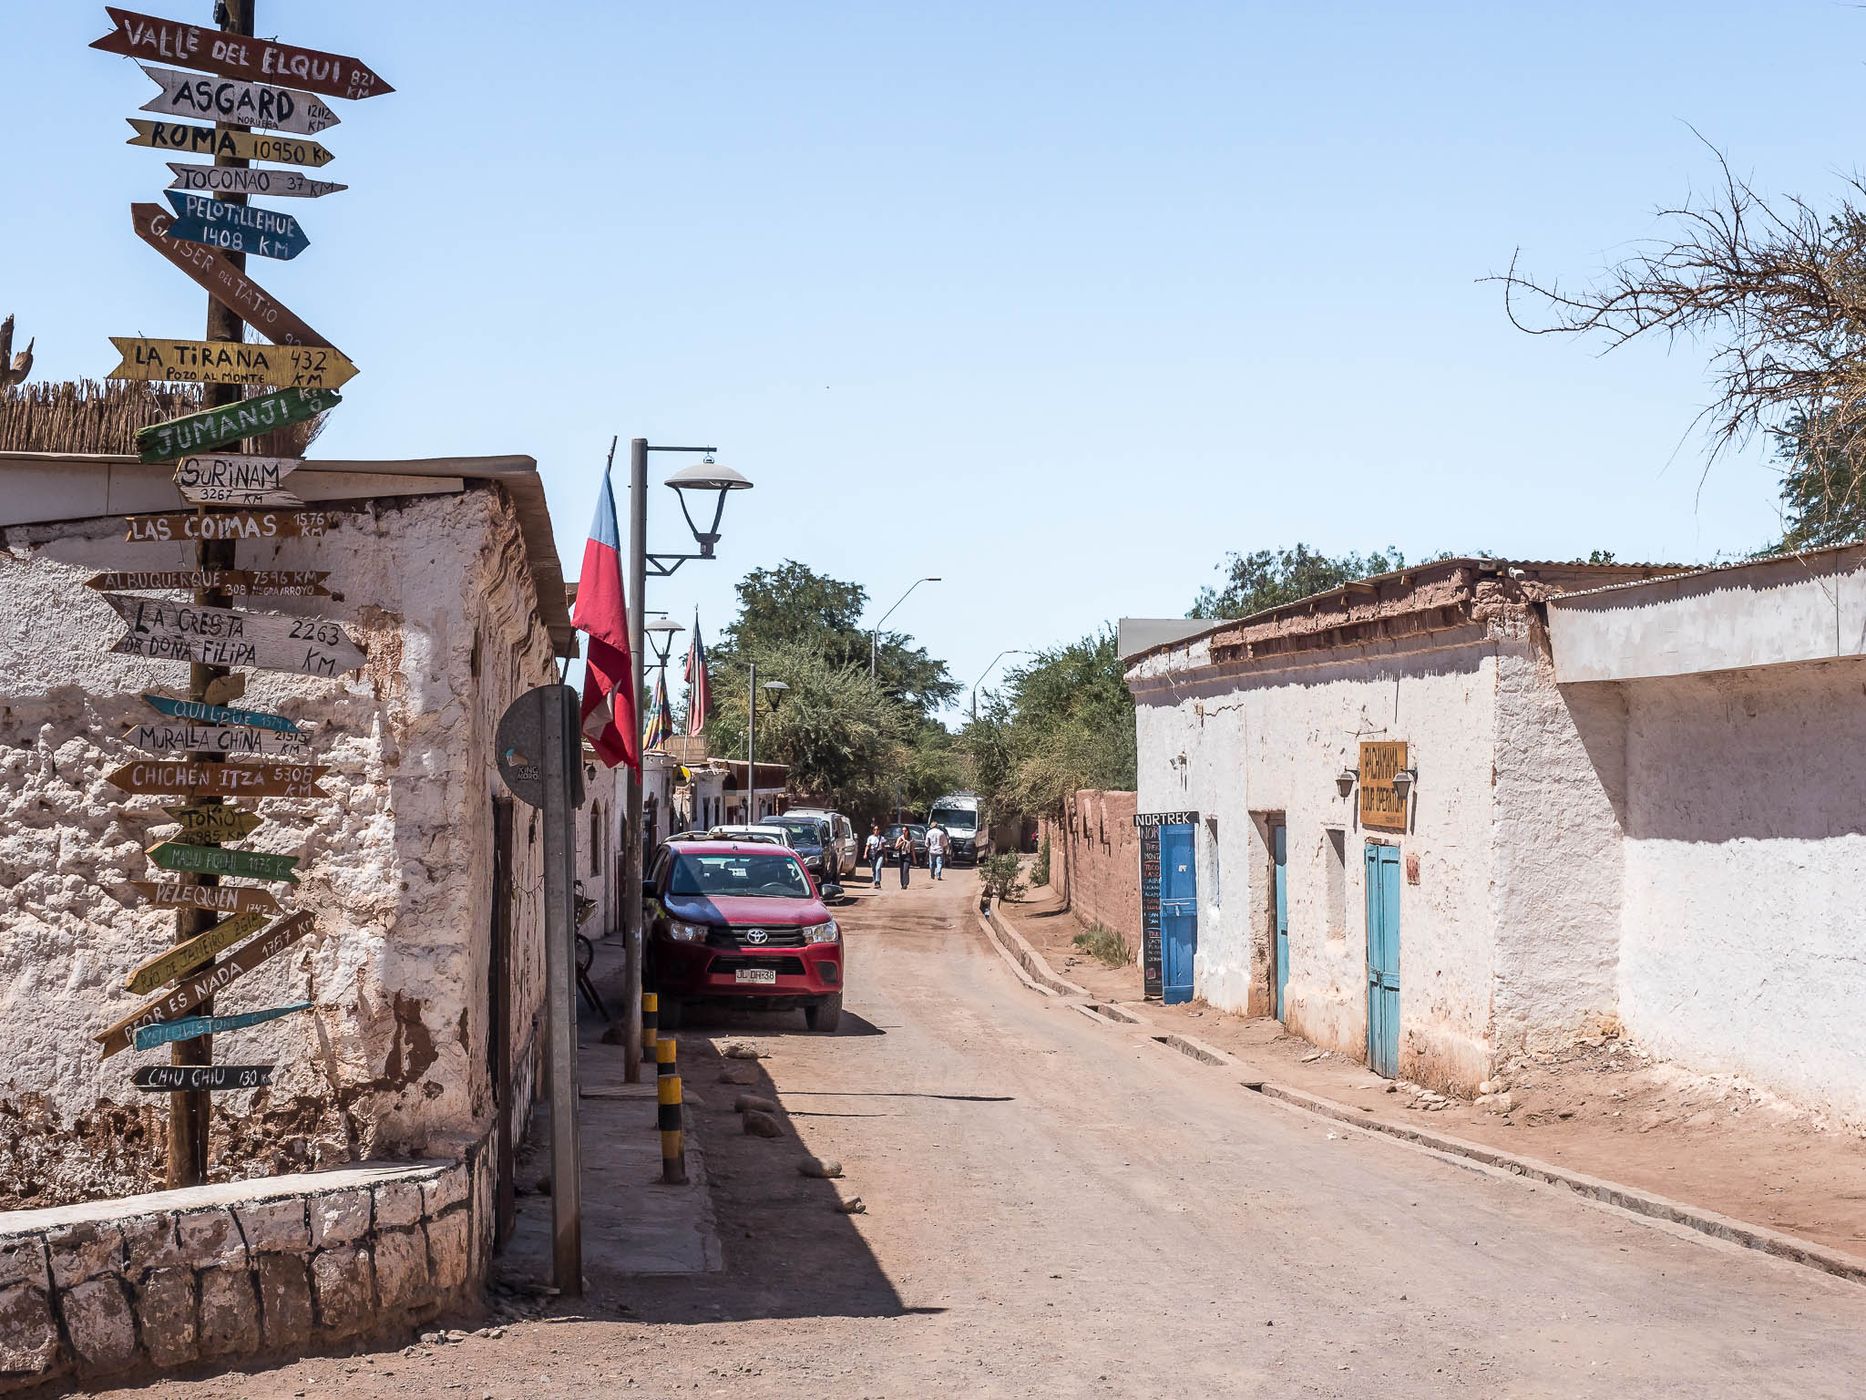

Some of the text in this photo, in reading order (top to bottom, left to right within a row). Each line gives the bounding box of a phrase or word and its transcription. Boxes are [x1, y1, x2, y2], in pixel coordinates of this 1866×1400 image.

[124, 19, 341, 84] VALLE DEL ELQUI
[349, 69, 375, 86] 821
[172, 80, 295, 121] ASGARD
[347, 86, 370, 98] KM
[307, 120, 326, 132] KM
[151, 121, 335, 164] ROMA 10950 KM
[180, 167, 335, 197] TOCONAO 37 KM
[203, 226, 290, 258] 1408 KM
[218, 270, 233, 287] DEL
[135, 345, 164, 368] LA
[291, 349, 328, 373] 432
[203, 369, 218, 382] AL
[221, 370, 265, 384] MONTE
[292, 373, 323, 387] KM
[156, 398, 289, 456] JUMANJI
[200, 487, 263, 505] 3267 KM
[293, 512, 325, 526] 1576
[131, 518, 172, 541] LAS
[301, 526, 323, 537] KM
[253, 571, 288, 585] 7596
[293, 570, 318, 584] KM
[225, 584, 247, 596] 308
[135, 602, 244, 638] LA CRESTA
[288, 620, 340, 646] 2263
[150, 634, 192, 658] DOÑA
[279, 743, 300, 755] KM
[132, 762, 210, 787] CHICHÉN
[284, 783, 312, 797] KM
[1135, 811, 1190, 826] NORTREK
[156, 883, 239, 910] PELEQUEN
[168, 992, 188, 1013] ES
[194, 962, 244, 1002] NADA
[261, 930, 292, 958] 1787
[239, 1069, 258, 1087] 130
